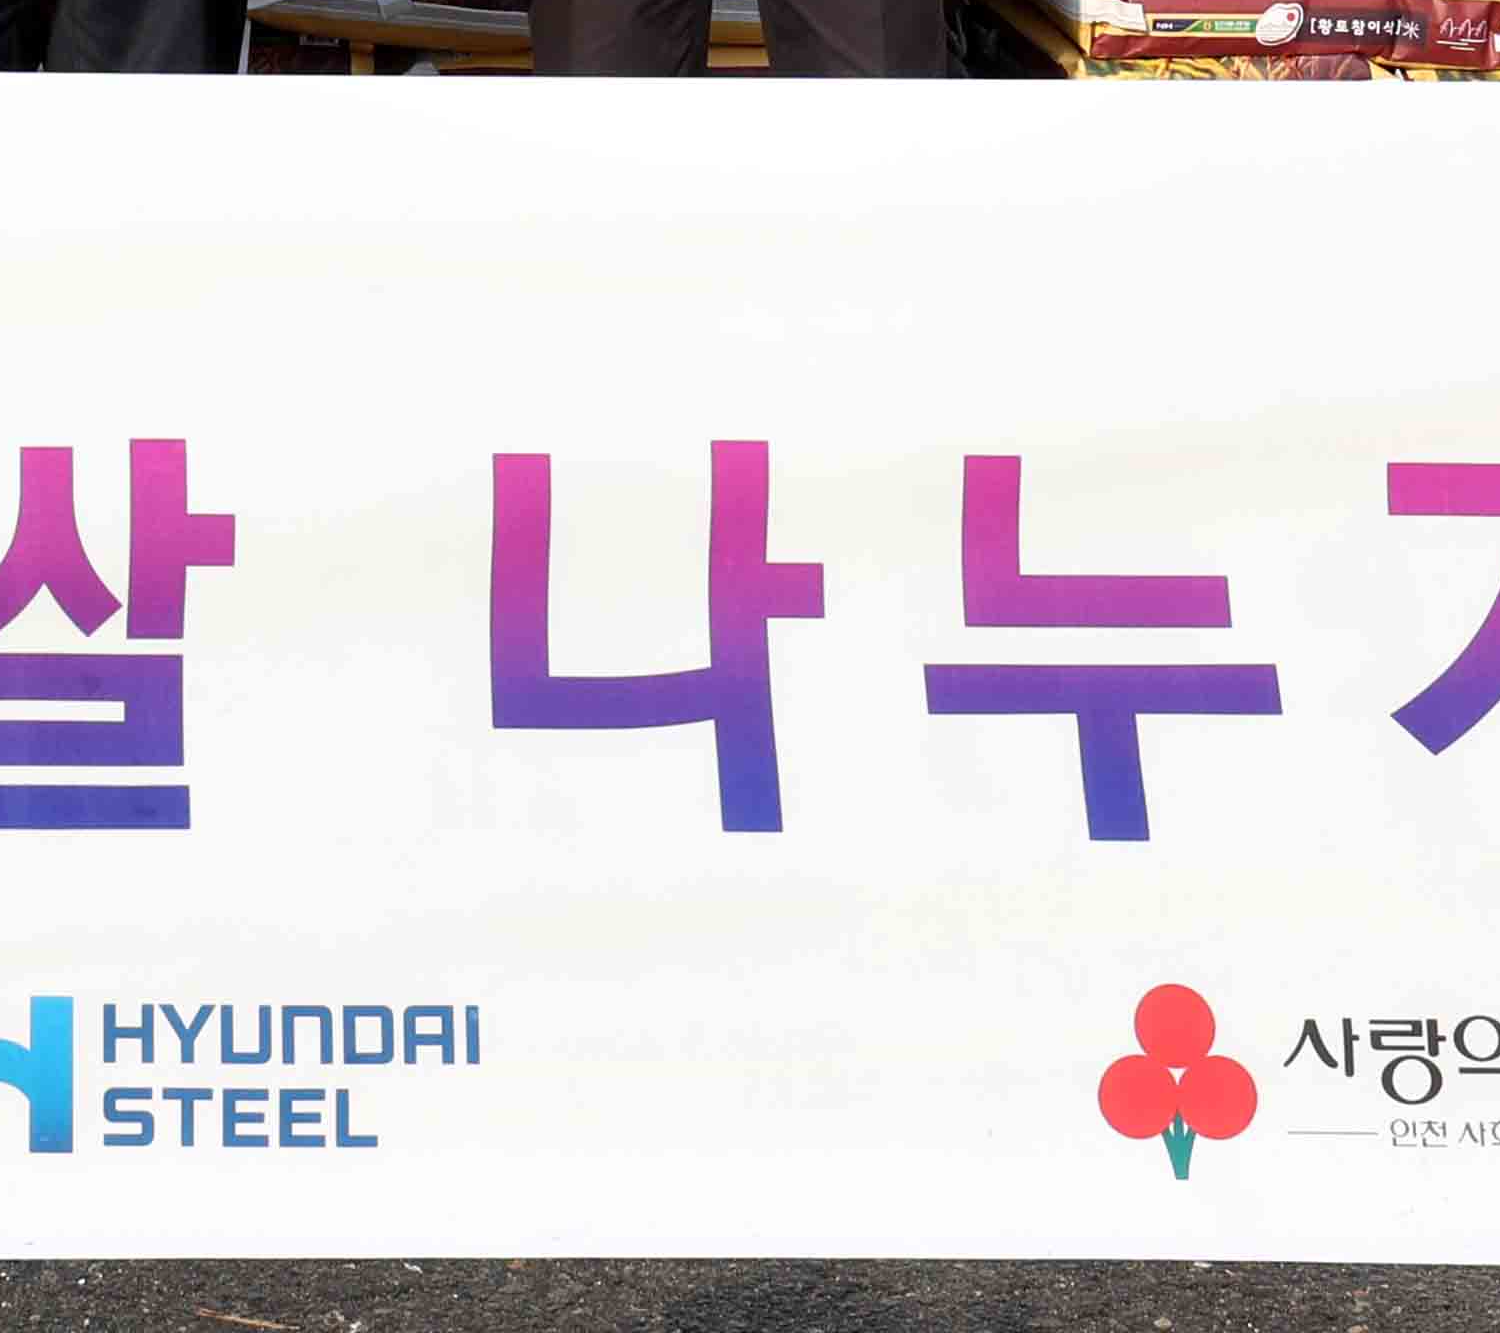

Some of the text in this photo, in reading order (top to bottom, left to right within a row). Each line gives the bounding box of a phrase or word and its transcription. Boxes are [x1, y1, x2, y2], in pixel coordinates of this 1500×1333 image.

[104, 1004, 480, 1064] HYUNDAI
[104, 1087, 378, 1147] STEEL
[1389, 1119, 1448, 1148] 인천
